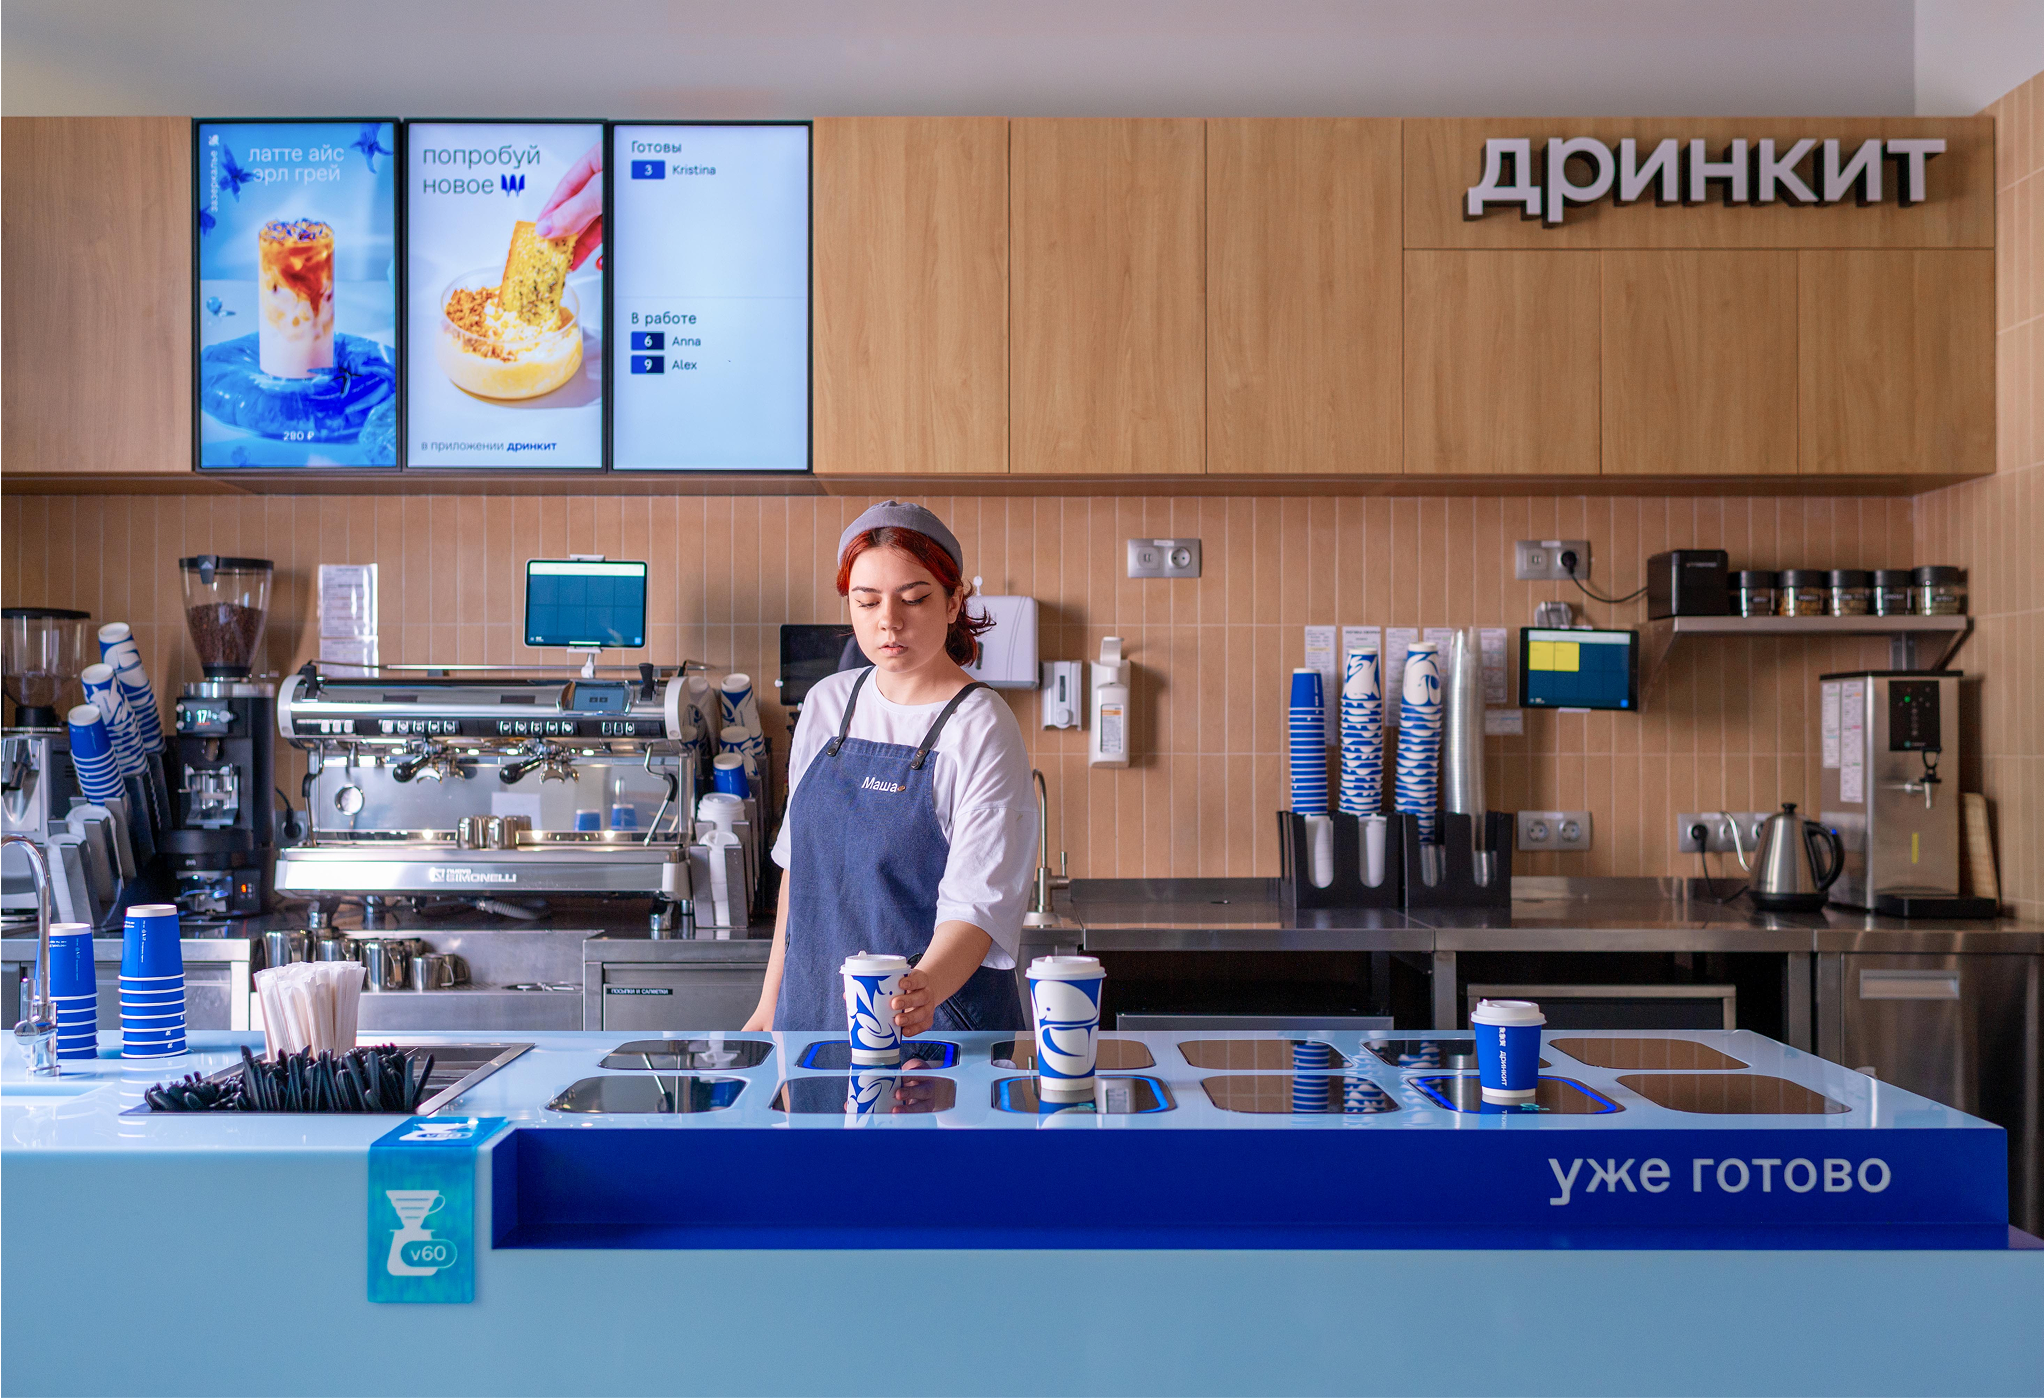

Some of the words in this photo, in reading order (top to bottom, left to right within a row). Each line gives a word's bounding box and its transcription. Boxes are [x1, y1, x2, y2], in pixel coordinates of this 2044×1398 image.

[248, 147, 303, 162] латте
[308, 143, 345, 162] айс
[631, 140, 682, 154] Готовы
[423, 144, 541, 170] попробуй
[252, 167, 289, 187] эрл
[295, 163, 341, 186] грей
[644, 163, 654, 177] 3
[672, 164, 717, 176] Kristina
[423, 178, 494, 195] новое
[1467, 136, 1947, 223] дринкит
[631, 311, 640, 325] В
[645, 310, 697, 328] работе
[644, 334, 653, 348] 6
[672, 336, 702, 347] Anna
[644, 358, 653, 372] 9
[672, 359, 698, 371] Alex
[283, 430, 305, 441] 280
[421, 441, 428, 451] в
[431, 441, 505, 453] приложении
[507, 442, 557, 453] дринкит
[861, 776, 899, 793] Маша
[1499, 1050, 1508, 1087] дринкит
[1548, 1157, 1671, 1206] уже
[1693, 1157, 1892, 1194] готово
[410, 1245, 447, 1262] v60
